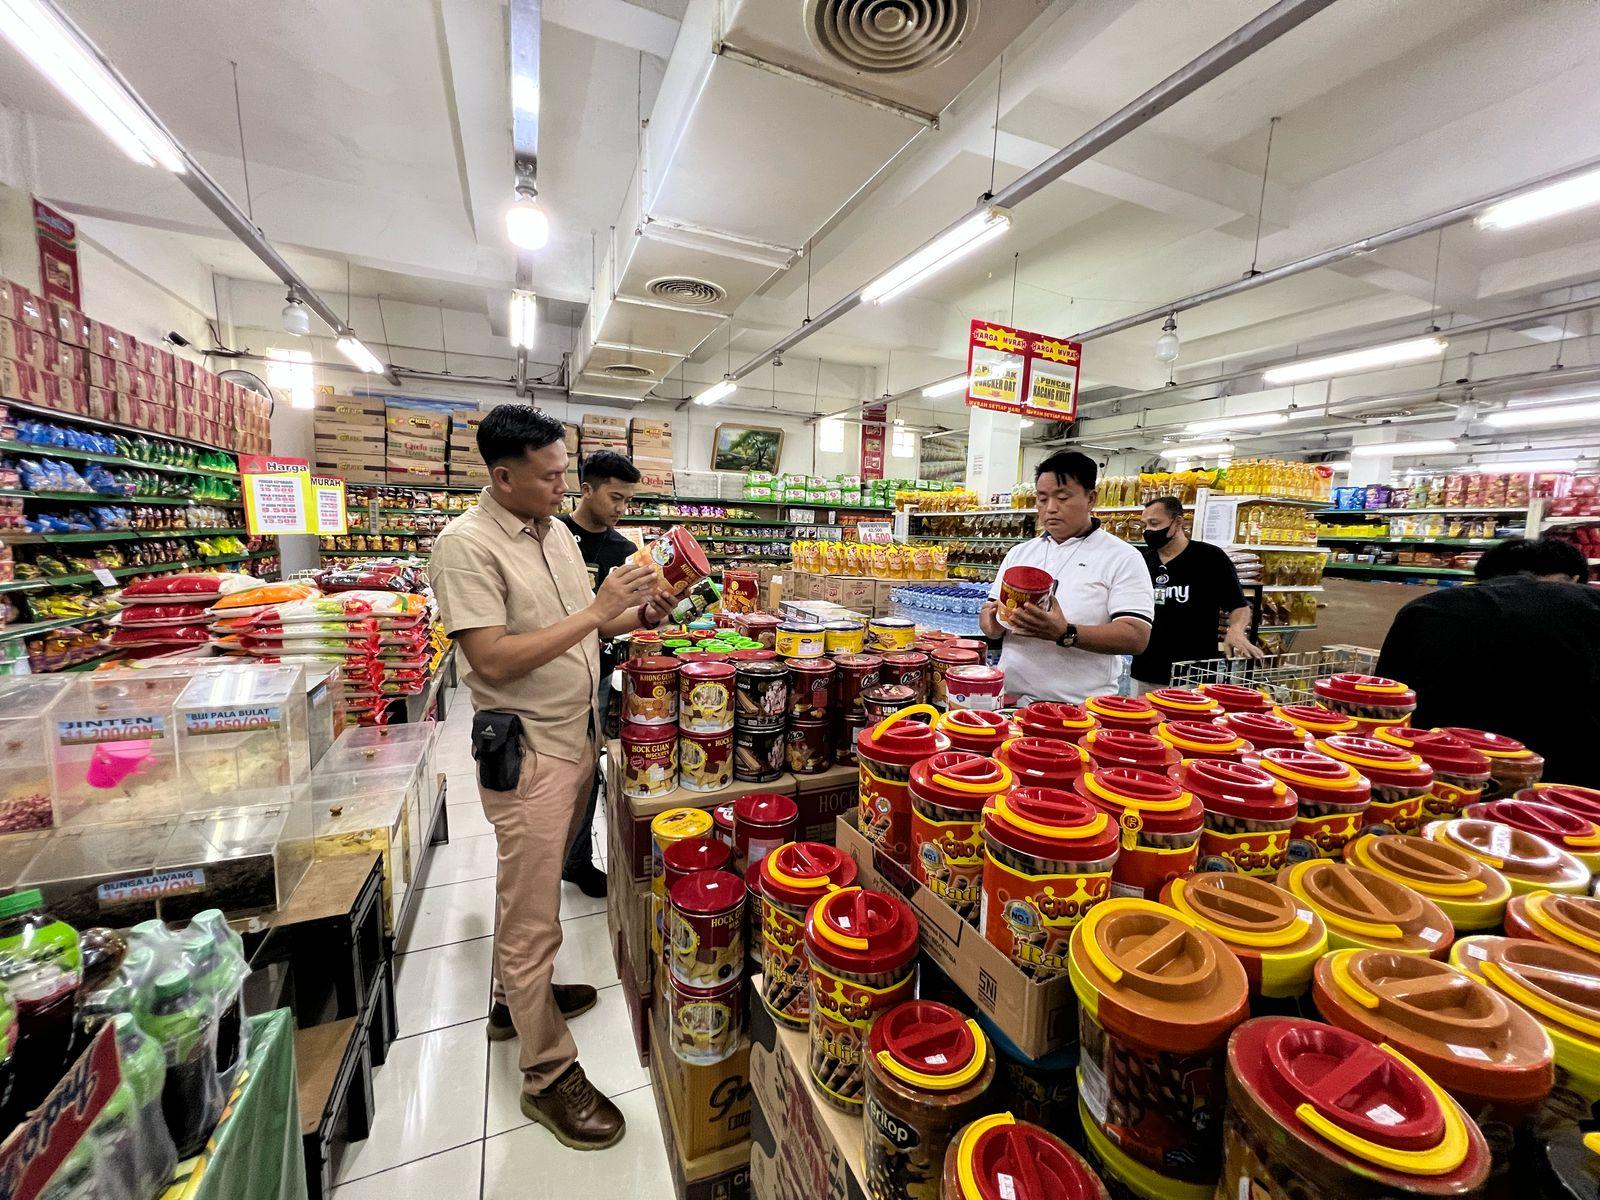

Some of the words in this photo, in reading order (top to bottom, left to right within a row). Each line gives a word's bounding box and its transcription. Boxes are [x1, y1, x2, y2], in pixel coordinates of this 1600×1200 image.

[974, 331, 998, 342] HARGA
[1032, 343, 1054, 354] HARGA
[1041, 376, 1071, 389] PUNCAK
[1033, 385, 1055, 400] KACANG
[1055, 389, 1070, 402] KULIT
[267, 462, 307, 473] Harga
[311, 478, 341, 487] MURAH
[863, 532, 891, 542] 41.500
[640, 674, 661, 682] KHONG
[210, 710, 236, 720] PALA
[238, 708, 270, 717] BULAT
[66, 716, 153, 730] JINTEN
[632, 744, 650, 753] HOCK
[651, 742, 670, 752] GUAN
[818, 791, 857, 813] HOCK
[923, 851, 937, 863] NO.1
[103, 879, 144, 891] BUNGA
[146, 870, 194, 885] LAWANG
[711, 913, 735, 928] HOCK
[1011, 911, 1029, 925] NO.1
[979, 974, 998, 1001] SNI
